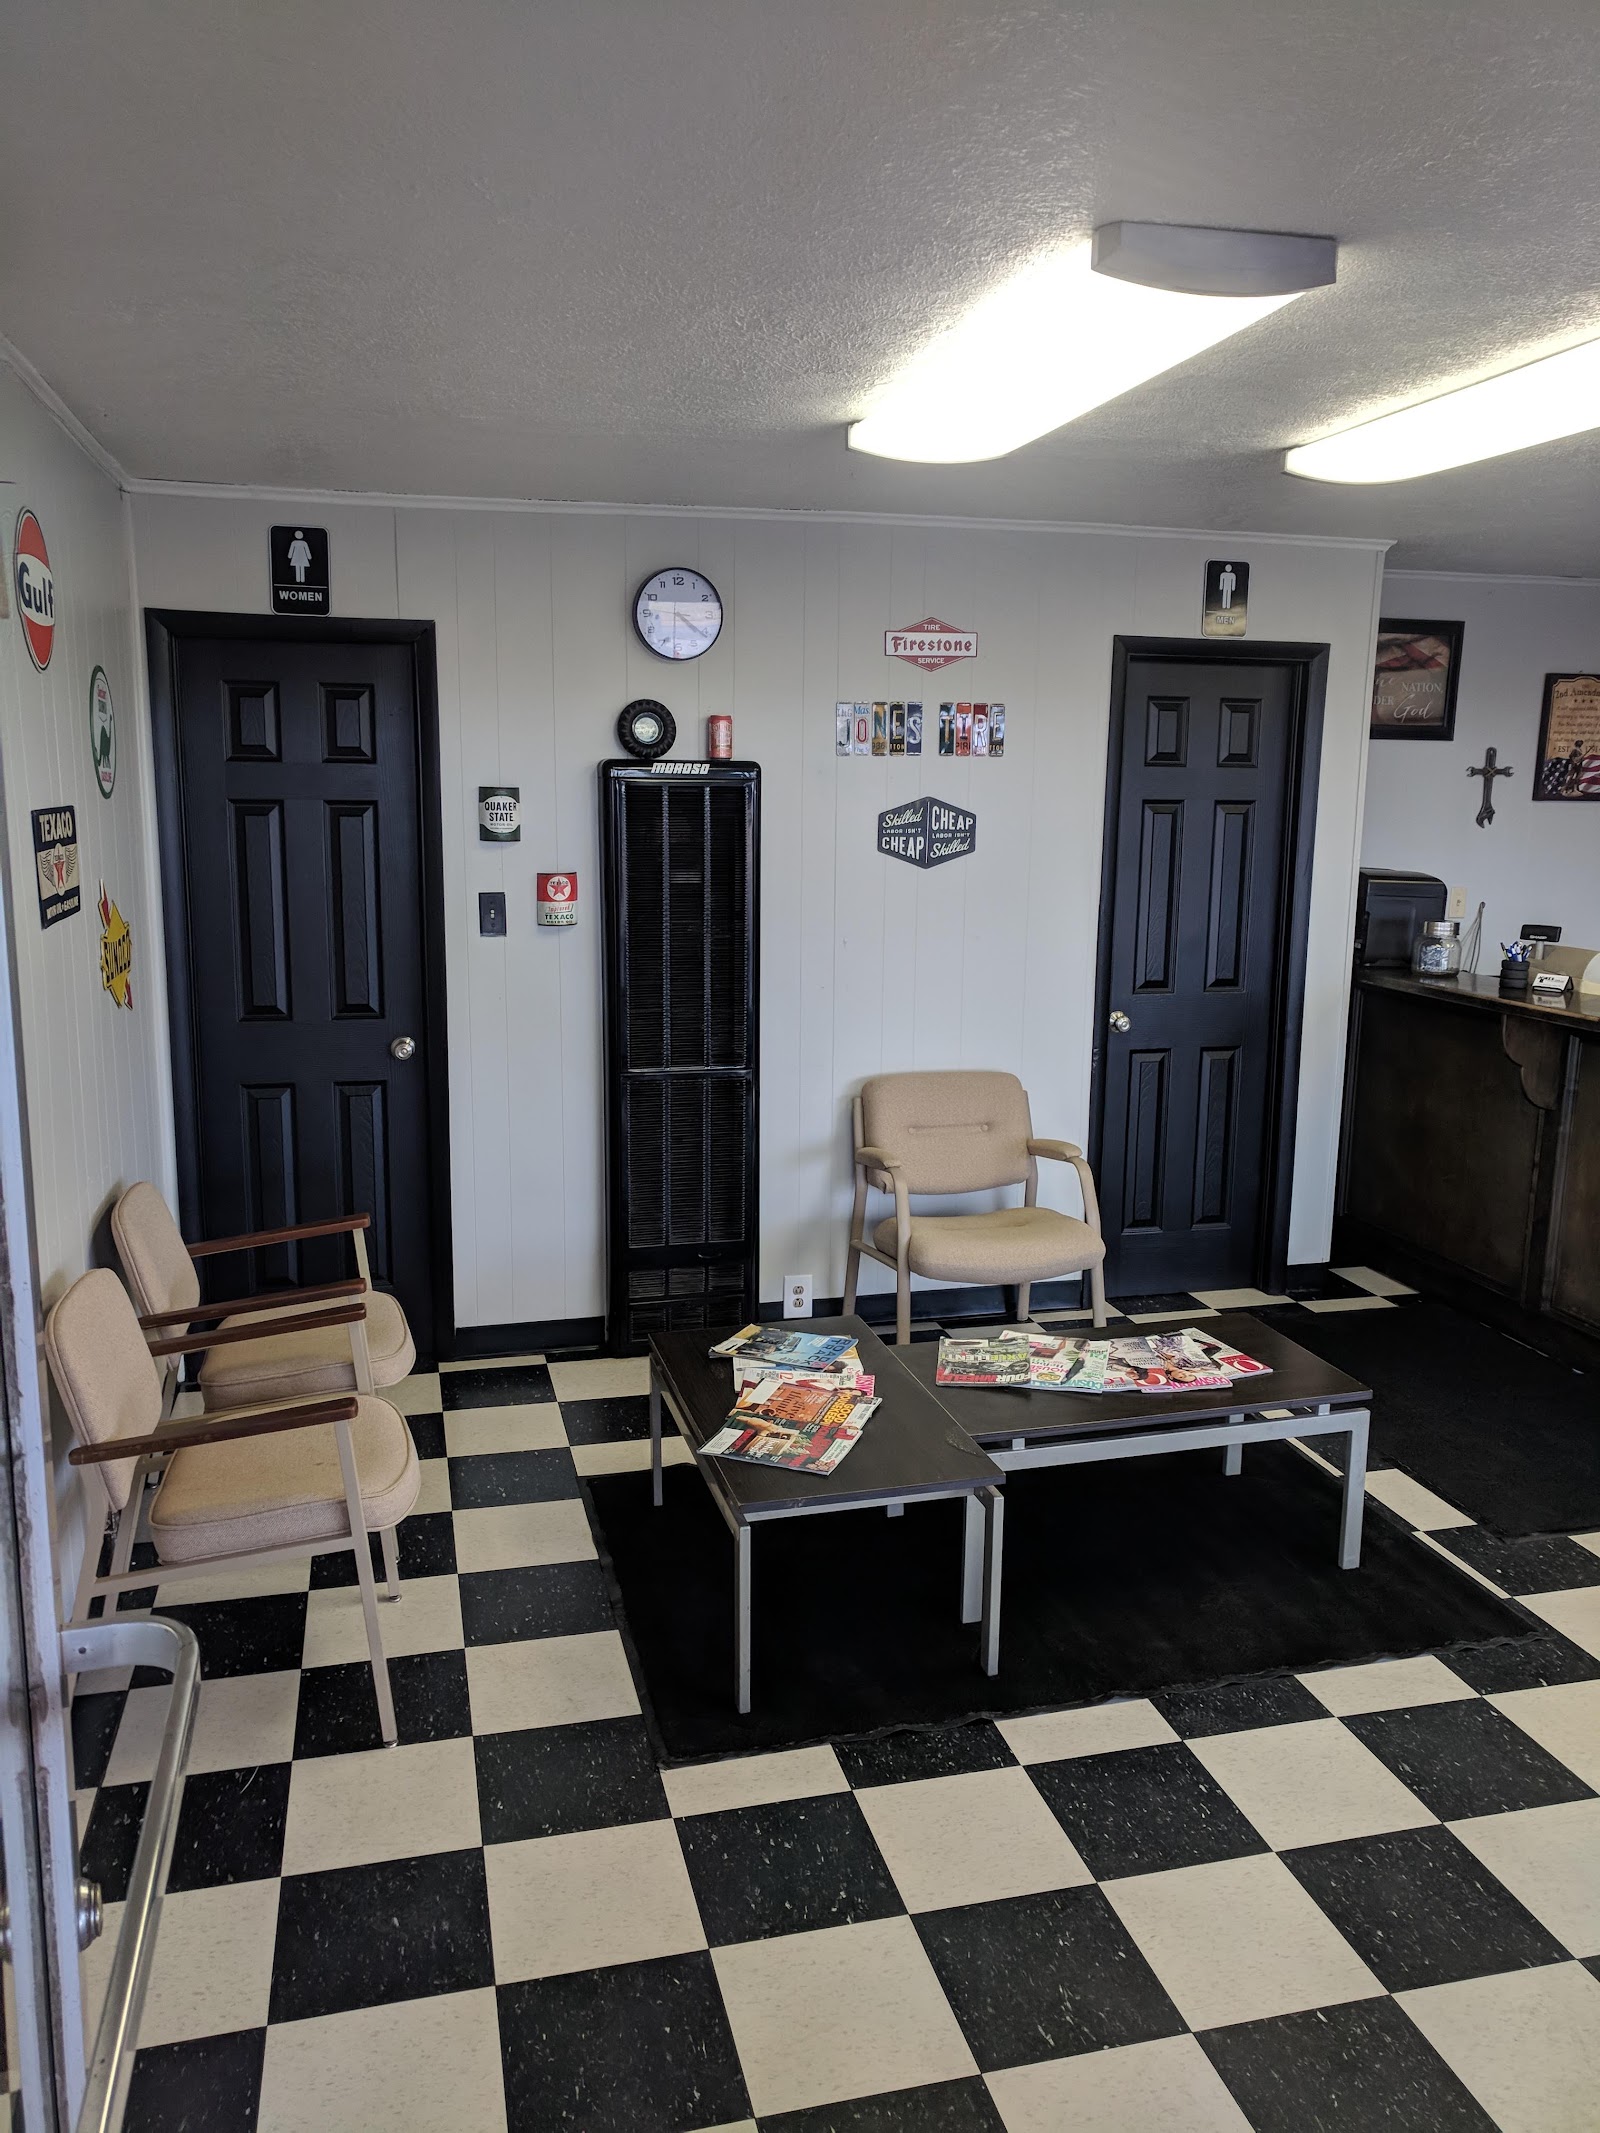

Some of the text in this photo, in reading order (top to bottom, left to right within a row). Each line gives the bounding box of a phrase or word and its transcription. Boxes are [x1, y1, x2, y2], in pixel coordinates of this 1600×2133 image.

[672, 577, 684, 585] 12
[18, 561, 53, 618] Gulf
[279, 590, 322, 601] WOMEN
[647, 593, 657, 601] 10
[701, 594, 708, 602] 2
[643, 609, 651, 617] 9
[705, 611, 713, 619] 3
[1216, 616, 1235, 624] MEN
[891, 636, 972, 653] Firestone
[1402, 682, 1443, 693] NATION,
[1555, 688, 1568, 698] 2nd
[1373, 694, 1433, 723] DER God
[838, 710, 1004, 747] JONES TIRE
[651, 762, 710, 774] MOROSO
[484, 801, 517, 811] QUAKER
[489, 812, 514, 821] STATE
[882, 807, 924, 828] Skilled
[931, 805, 974, 831] CHEAP
[39, 811, 73, 843] TEXACO
[881, 836, 924, 860] CHEAP
[930, 838, 971, 858] Skilled
[104, 929, 131, 984] SUNOCO
[804, 1338, 838, 1366] TRACK
[821, 1338, 853, 1365] ROAD
[995, 1372, 1031, 1383] FOUR
[834, 1403, 855, 1424] GOOD
